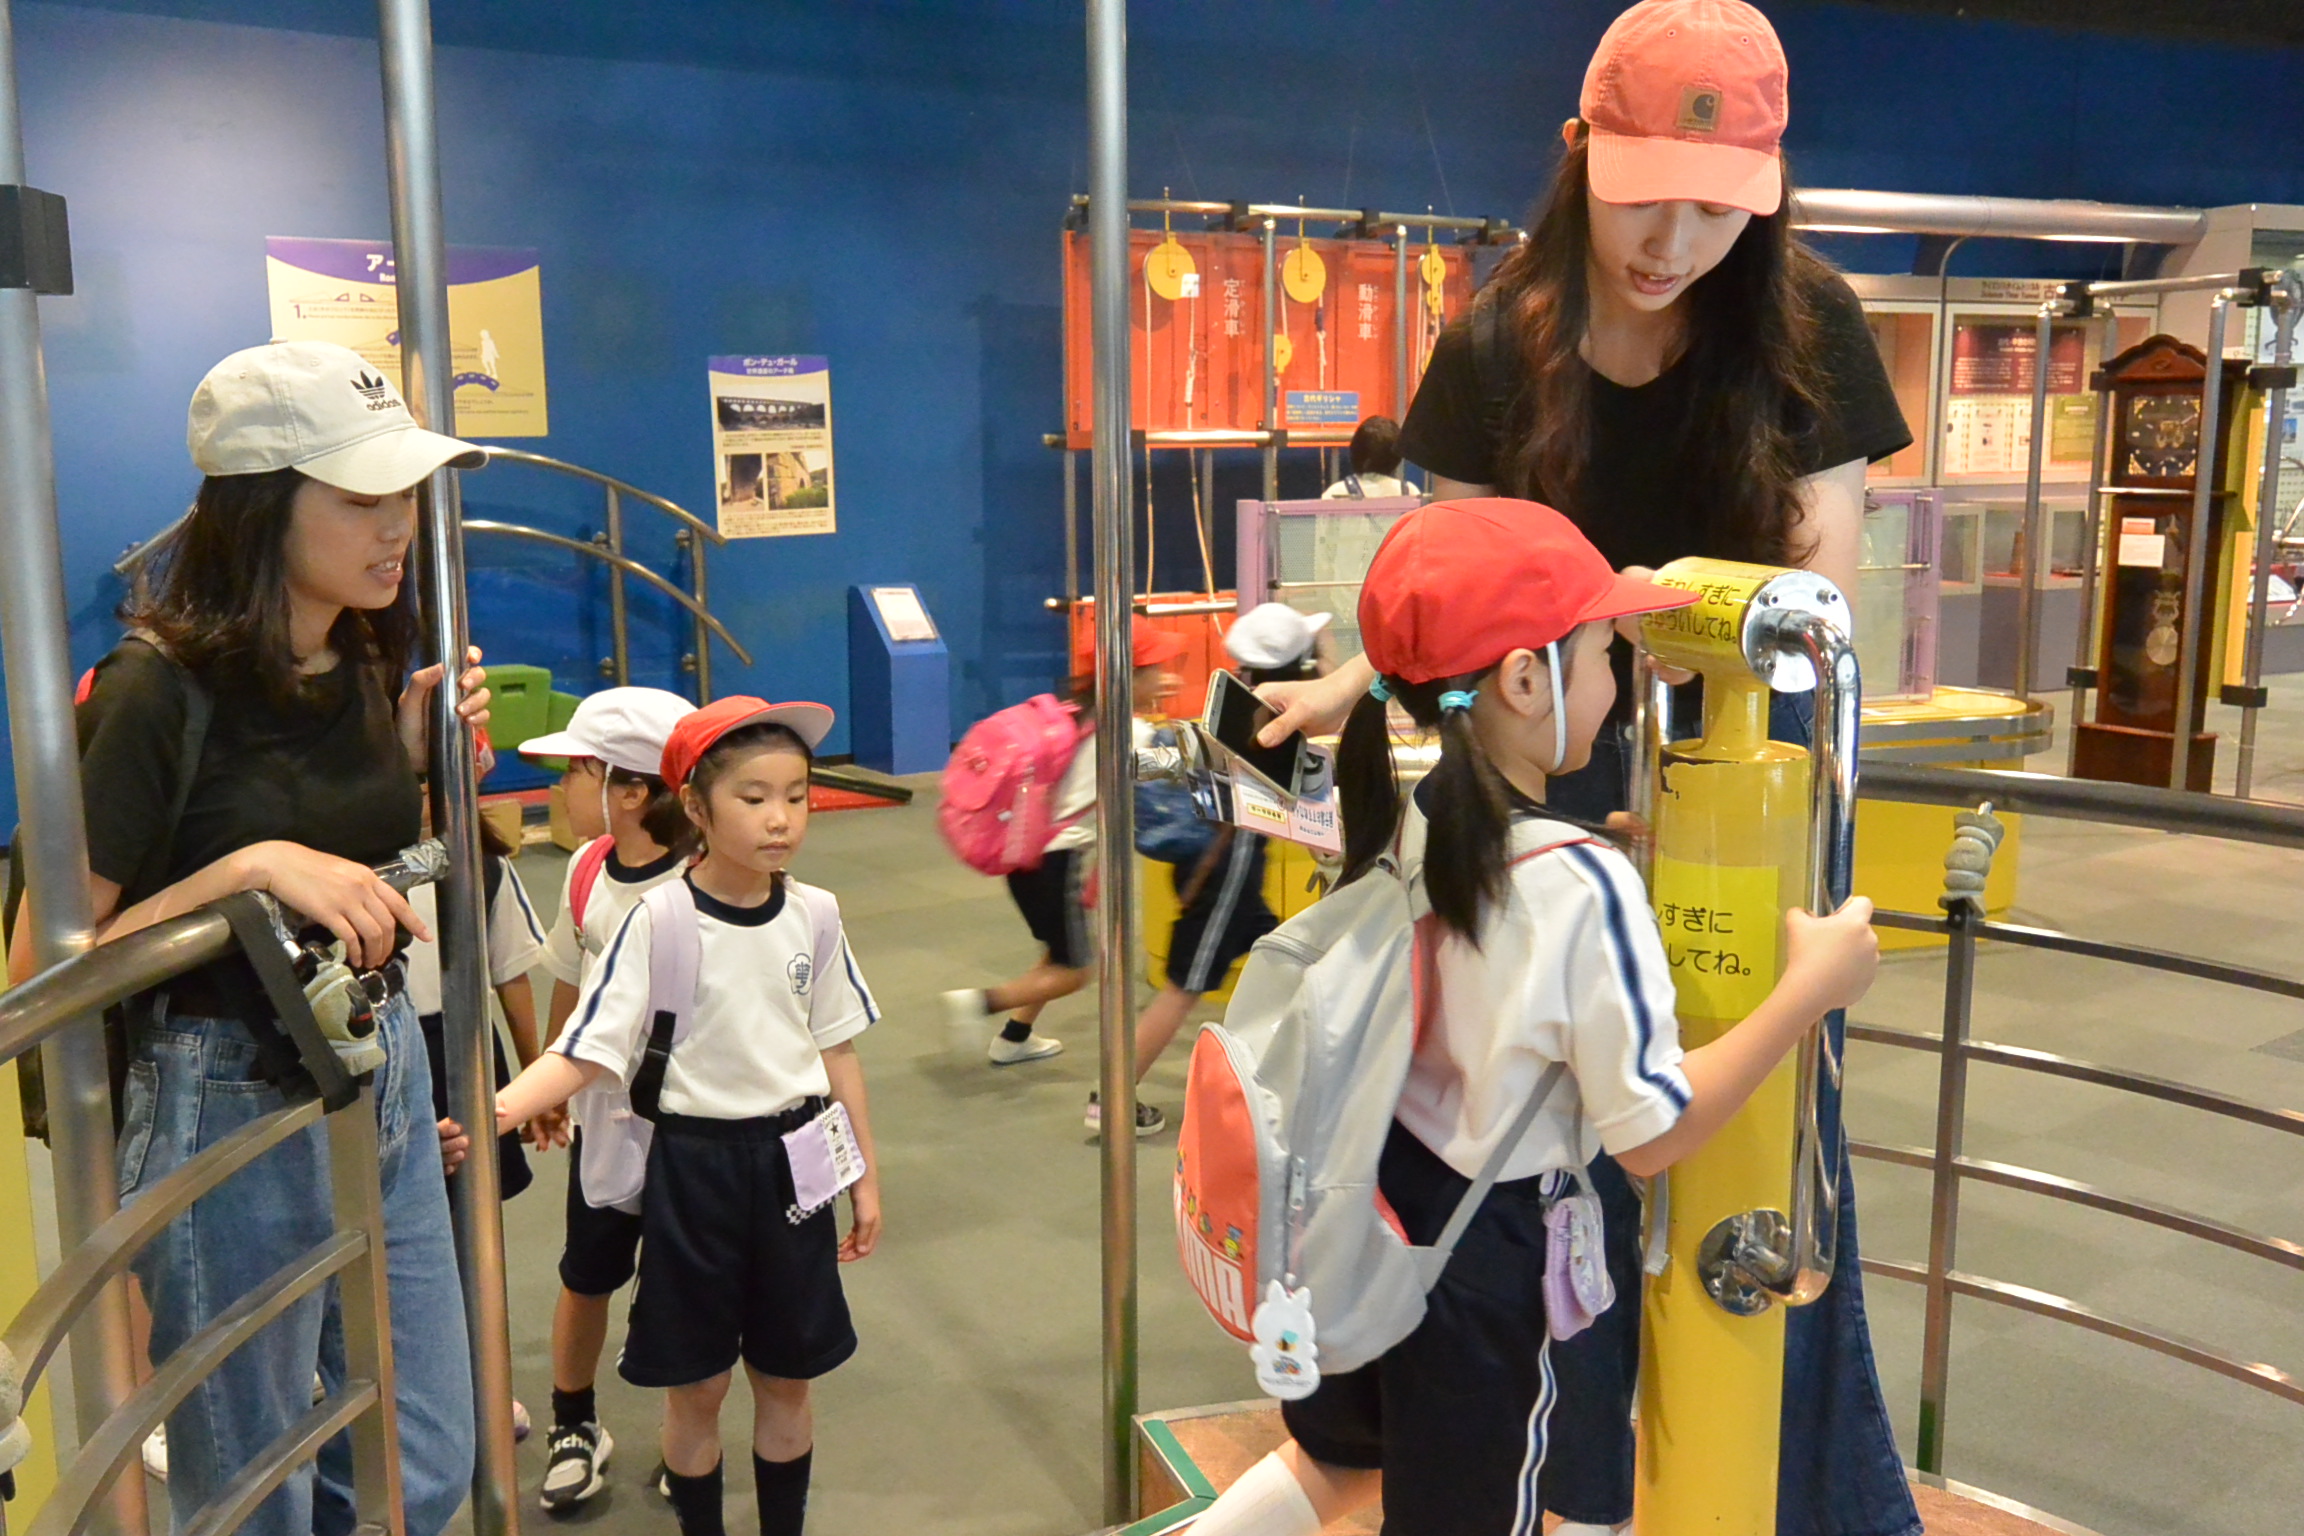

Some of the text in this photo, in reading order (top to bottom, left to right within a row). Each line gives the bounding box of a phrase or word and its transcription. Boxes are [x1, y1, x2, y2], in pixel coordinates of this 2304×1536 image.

[1223, 278, 1240, 338] 定滑車
[1357, 283, 1373, 341] 動滑車
[1658, 902, 1734, 933] すぎに
[1668, 942, 1751, 976] してね。
